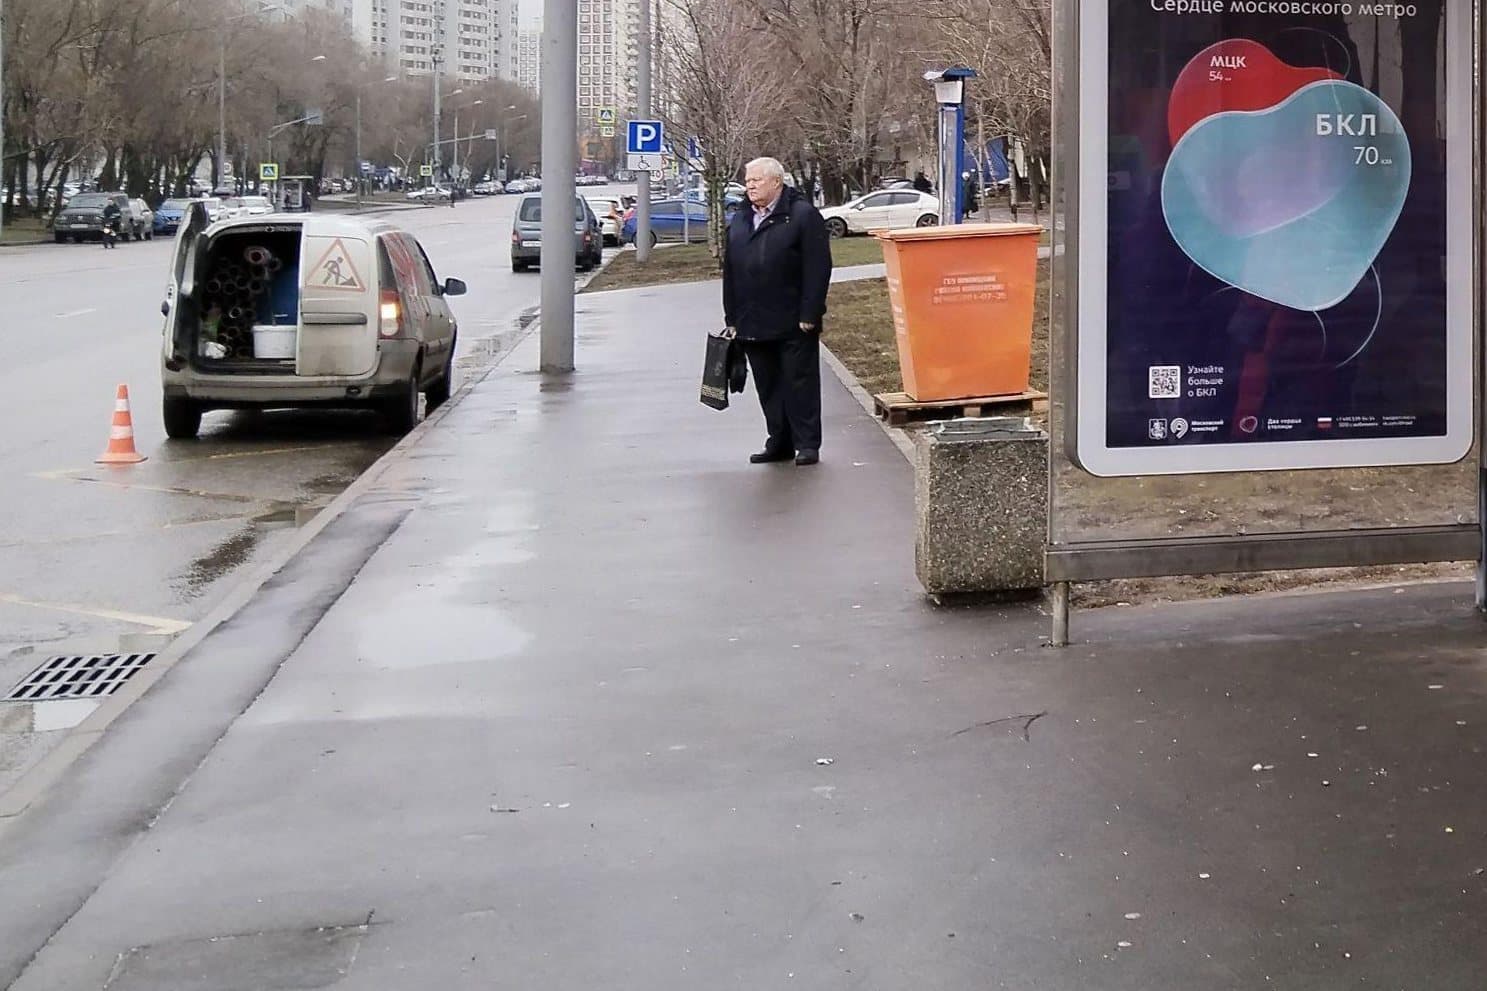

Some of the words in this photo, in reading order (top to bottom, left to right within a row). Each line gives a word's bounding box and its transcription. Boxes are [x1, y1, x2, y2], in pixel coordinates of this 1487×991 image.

[1229, 0, 1353, 16] московского
[1358, 2, 1417, 20] метро
[1209, 55, 1247, 69] МЦК
[1208, 70, 1224, 82] 54
[1316, 113, 1377, 137] БКЛ
[636, 123, 657, 150] P
[1353, 146, 1379, 165] 70
[1187, 365, 1225, 375] Узнайте
[1187, 376, 1224, 386] больше
[1187, 389, 1195, 398] о
[1196, 387, 1217, 398] БКЛ
